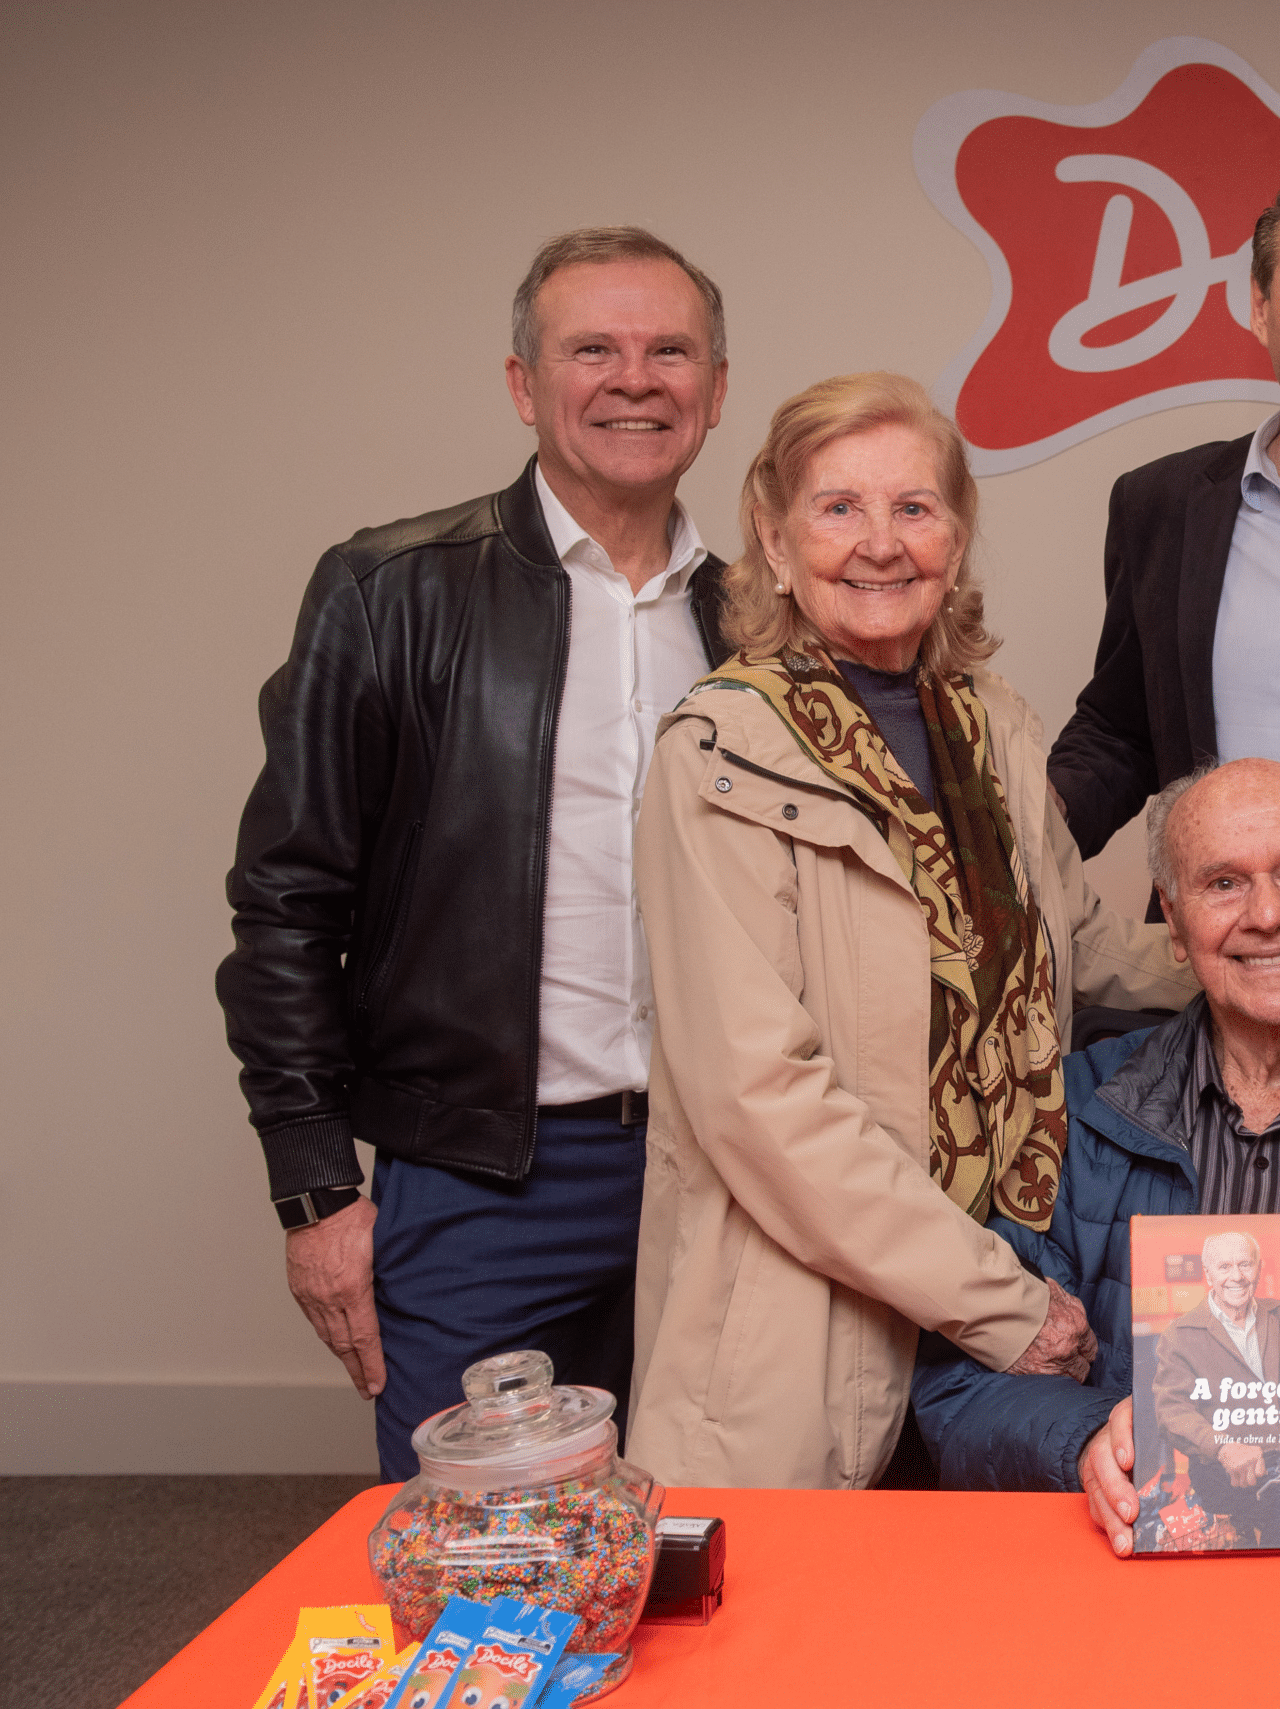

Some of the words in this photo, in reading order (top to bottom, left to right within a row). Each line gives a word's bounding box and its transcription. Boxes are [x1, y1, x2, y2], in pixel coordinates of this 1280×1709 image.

[1189, 1377, 1212, 1401] A
[1213, 1434, 1234, 1445] Vida
[1243, 1433, 1264, 1444] obra
[1266, 1434, 1276, 1444] de
[322, 1654, 375, 1675] Docile
[428, 1654, 458, 1669] Doc
[477, 1650, 528, 1675] Docile
